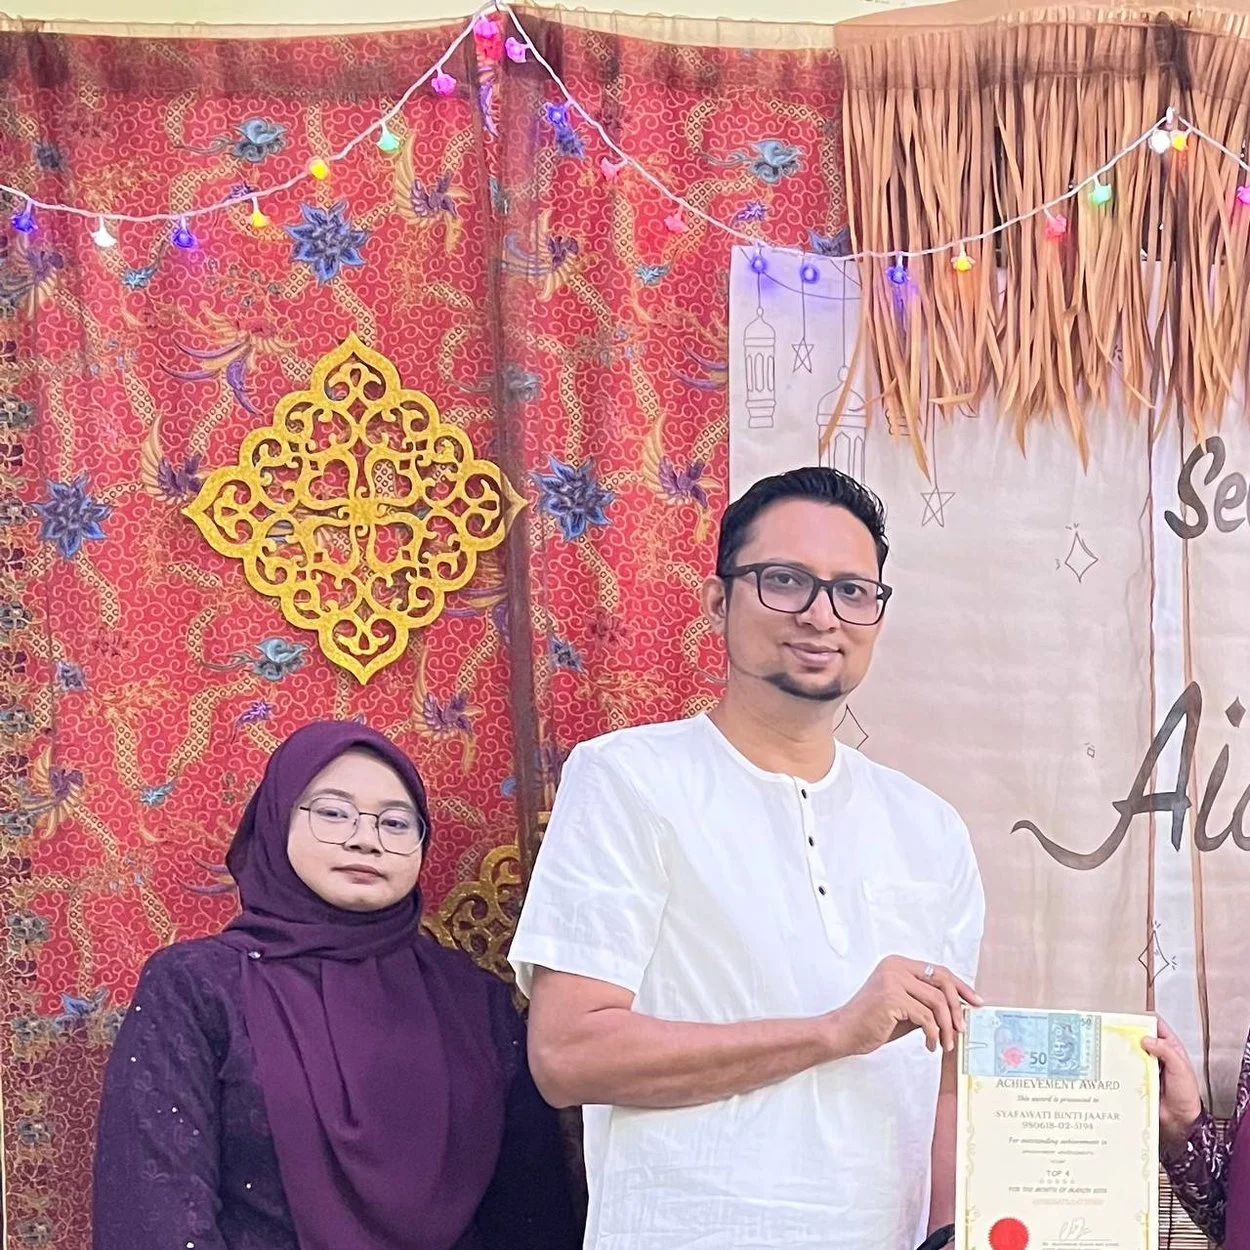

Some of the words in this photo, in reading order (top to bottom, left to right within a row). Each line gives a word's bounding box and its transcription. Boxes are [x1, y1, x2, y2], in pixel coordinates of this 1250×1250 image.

[1029, 1051, 1048, 1065] 50
[995, 1078, 1075, 1090] ACHIEVEMENT
[1079, 1079, 1120, 1091] AWARD
[1053, 1111, 1083, 1120] BINTI
[1084, 1112, 1121, 1121] JAAFAR
